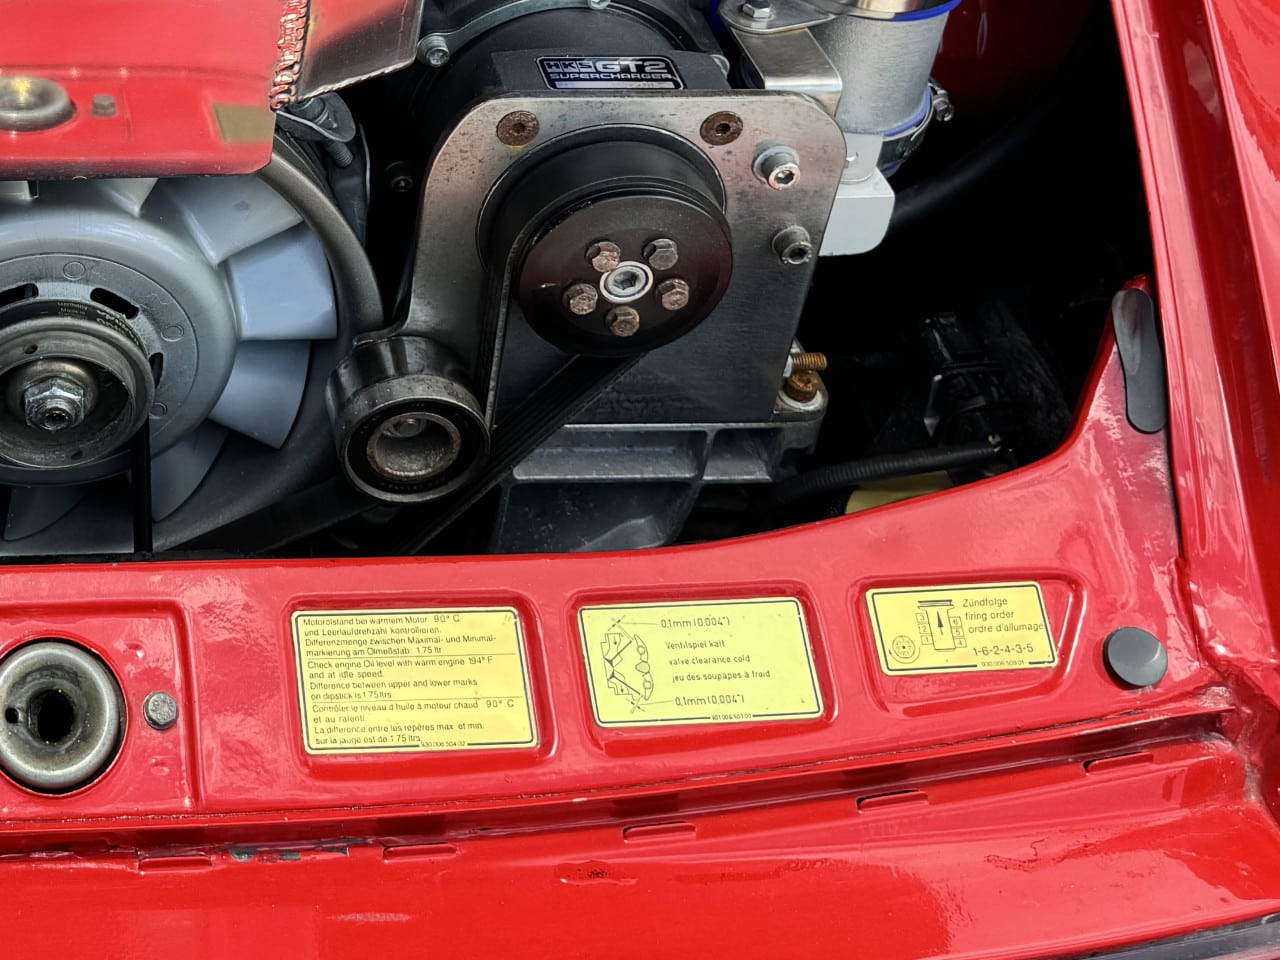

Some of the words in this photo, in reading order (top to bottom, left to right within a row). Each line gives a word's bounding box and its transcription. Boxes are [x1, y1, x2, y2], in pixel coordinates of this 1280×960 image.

[596, 61, 668, 73] GT2
[550, 73, 673, 81] SUPERCHARGER
[965, 611, 988, 621] firing
[990, 610, 1014, 619] order
[968, 624, 993, 633] ordre
[995, 622, 1044, 632] d'allumage
[305, 638, 368, 647] Differenzmenge
[665, 640, 707, 650] Ventilspiel
[709, 639, 725, 648] kalt
[307, 649, 351, 658] markierung
[973, 644, 1034, 656] 1-6-2-4-3-5
[308, 661, 332, 669] Check
[335, 661, 361, 669] engine
[376, 659, 395, 667] level
[438, 658, 465, 667] engine
[669, 656, 689, 665] valve
[691, 655, 731, 665] clearance
[733, 654, 750, 663] cold
[309, 671, 324, 679] and
[672, 674, 684, 683] jeu
[686, 673, 701, 681] des
[703, 672, 742, 682] soupapes
[751, 669, 771, 678] froid
[310, 682, 350, 690] Difference
[388, 681, 410, 689] upper
[453, 678, 478, 686] marks
[323, 692, 352, 700] dipstick
[424, 702, 451, 710] moteur
[454, 701, 479, 709] chaud
[368, 724, 388, 732] entre
[330, 736, 338, 744] la
[339, 737, 361, 746] jauge
[378, 735, 387, 743] de
